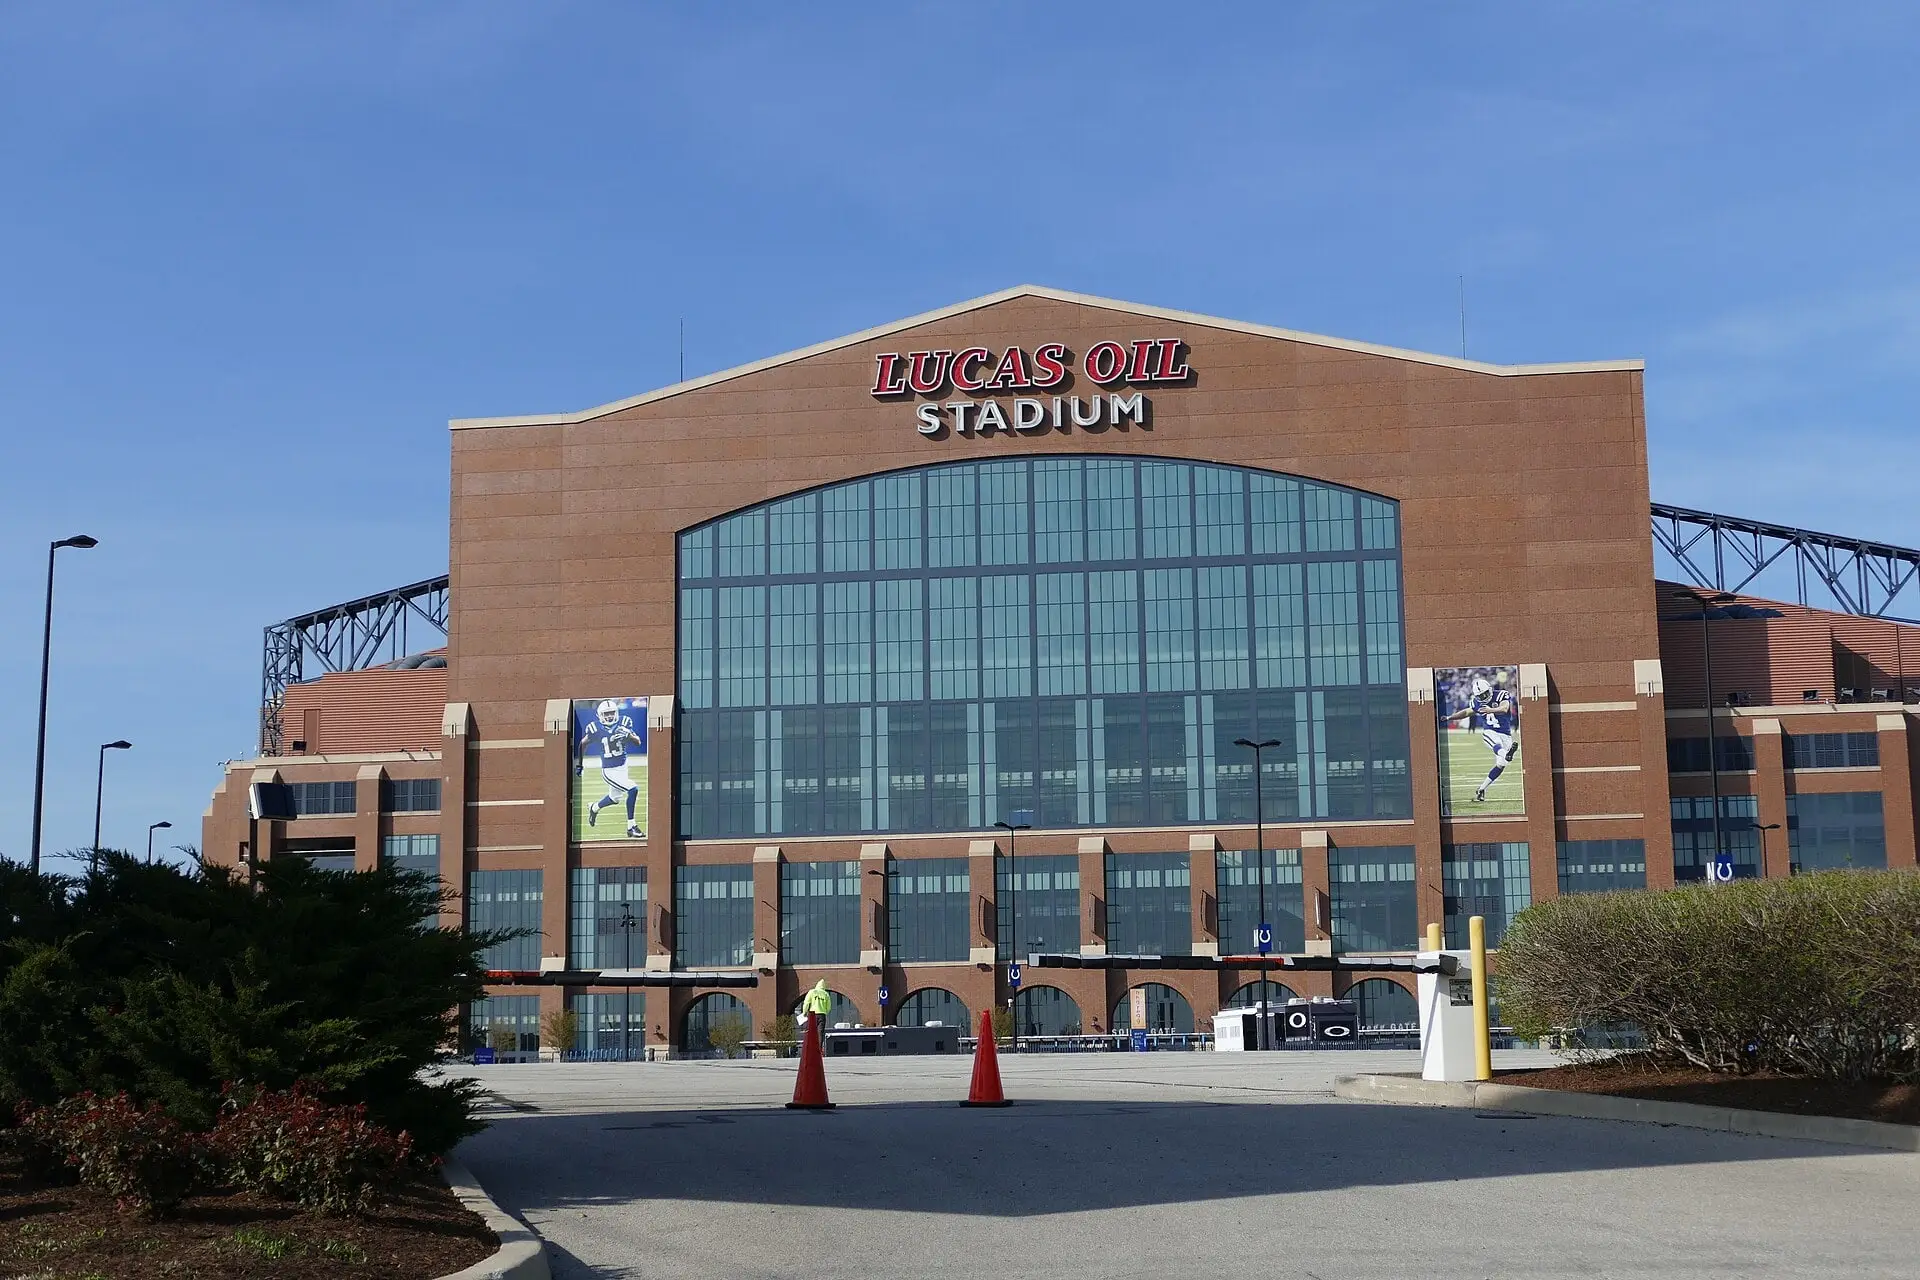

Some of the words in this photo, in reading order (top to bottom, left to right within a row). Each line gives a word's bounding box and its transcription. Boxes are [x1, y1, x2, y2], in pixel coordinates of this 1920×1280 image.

[871, 343, 1065, 395] LUCAS
[1084, 338, 1188, 383] OIL
[917, 393, 1143, 433] STADIUM
[1150, 1027, 1176, 1036] GATE
